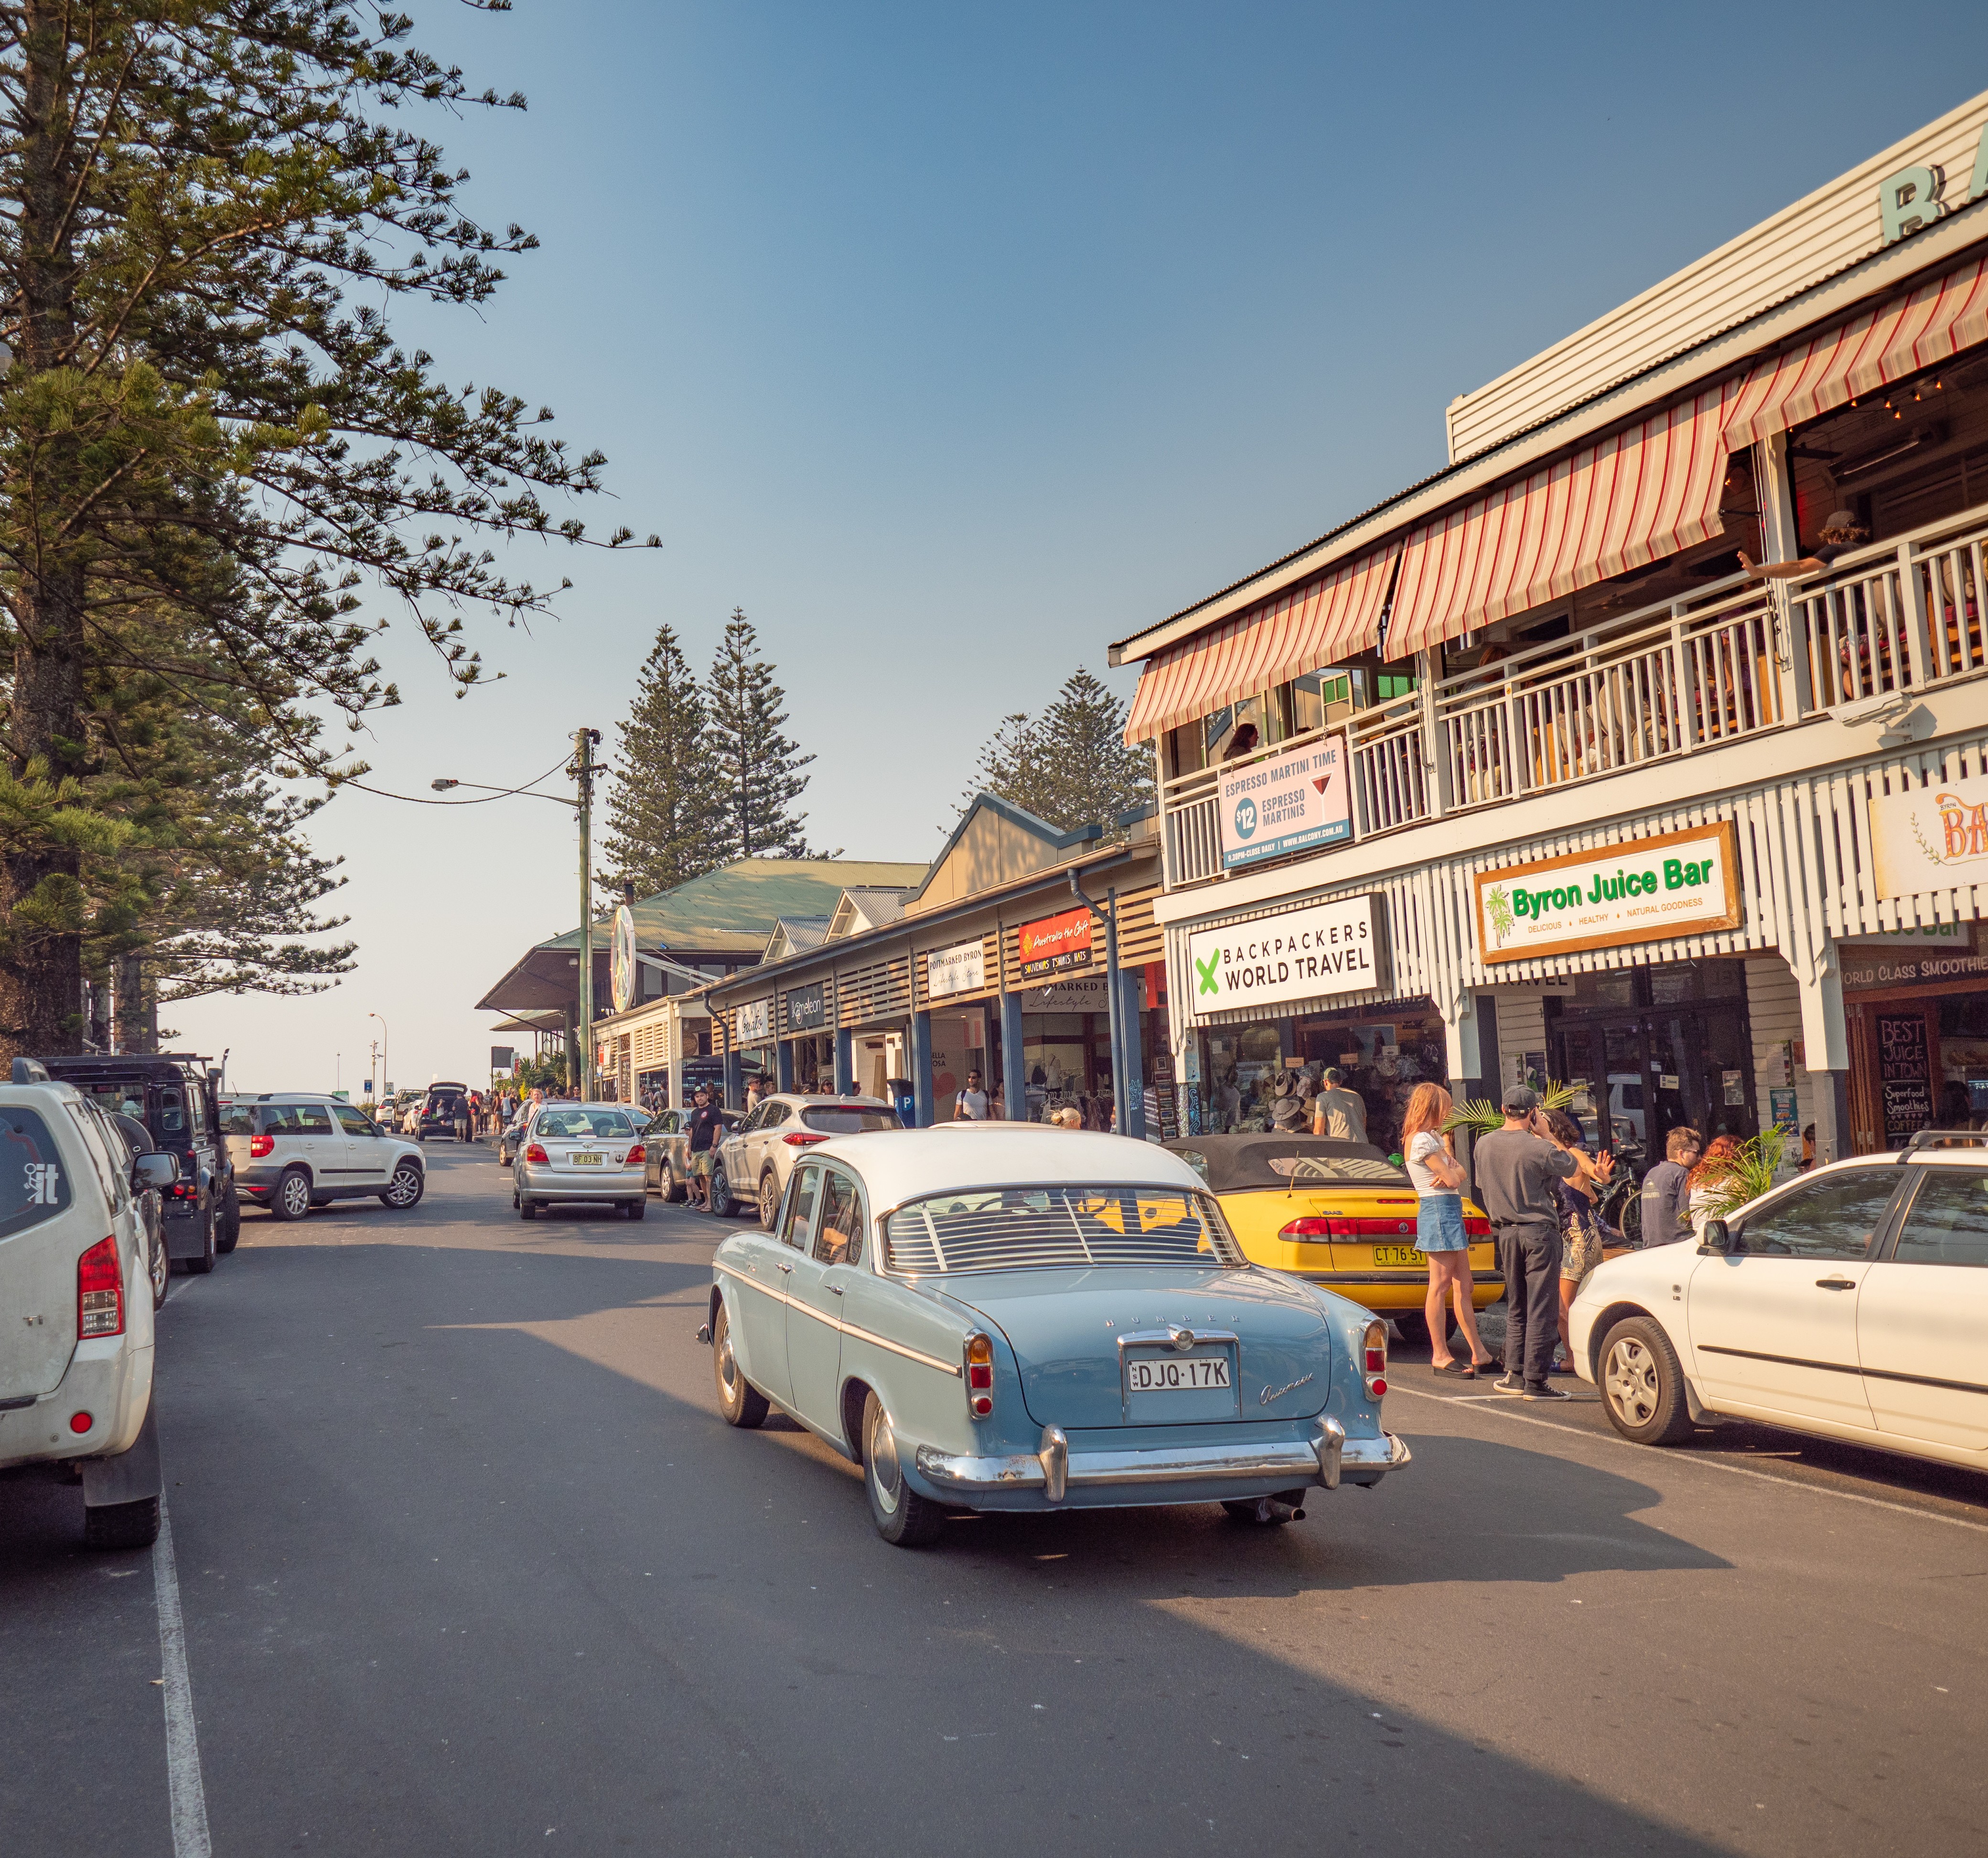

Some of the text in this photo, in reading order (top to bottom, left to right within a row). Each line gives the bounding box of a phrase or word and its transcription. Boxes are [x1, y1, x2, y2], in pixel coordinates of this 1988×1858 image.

[1225, 749, 1336, 798] ESPRESSO MARTINI TIME
[1262, 789, 1305, 812] ESPRESSO
[1940, 802, 1956, 810] BYRON
[1236, 806, 1255, 830] $12
[1263, 803, 1305, 827] MARTINIS
[1938, 795, 1988, 860] BA
[1261, 842, 1275, 854] DAILY
[1512, 858, 1713, 920] Byron Juice Bar
[1528, 897, 1703, 934] DELICIOUS HEALTHY NATURAL GOODNESS
[1033, 919, 1089, 949] Australia the Gift
[1224, 921, 1367, 964] BACKPACKERS
[930, 949, 982, 971] POSTMARKED BYRON
[1024, 960, 1050, 974] SOUVENIRS
[1074, 951, 1086, 963] HATS
[1225, 948, 1370, 991] WORLD TRAVEL
[933, 965, 979, 989] Lifestyle Store
[1841, 970, 1874, 985] ORLD
[1878, 964, 1916, 981] CLASS
[1029, 993, 1091, 1012] Lifestyle
[741, 1009, 763, 1034] Gelato
[1881, 1020, 1924, 1044] BEST
[1883, 1044, 1924, 1061] JUICE
[1884, 1061, 1927, 1078] IN TOWN
[904, 1097, 911, 1108] P
[1885, 1086, 1924, 1102] Superfood
[1887, 1099, 1930, 1114] Smoothies
[1888, 1121, 1924, 1132] COFFEE
[1105, 1314, 1241, 1327] HUMBER
[1259, 1372, 1314, 1406] Automatic
